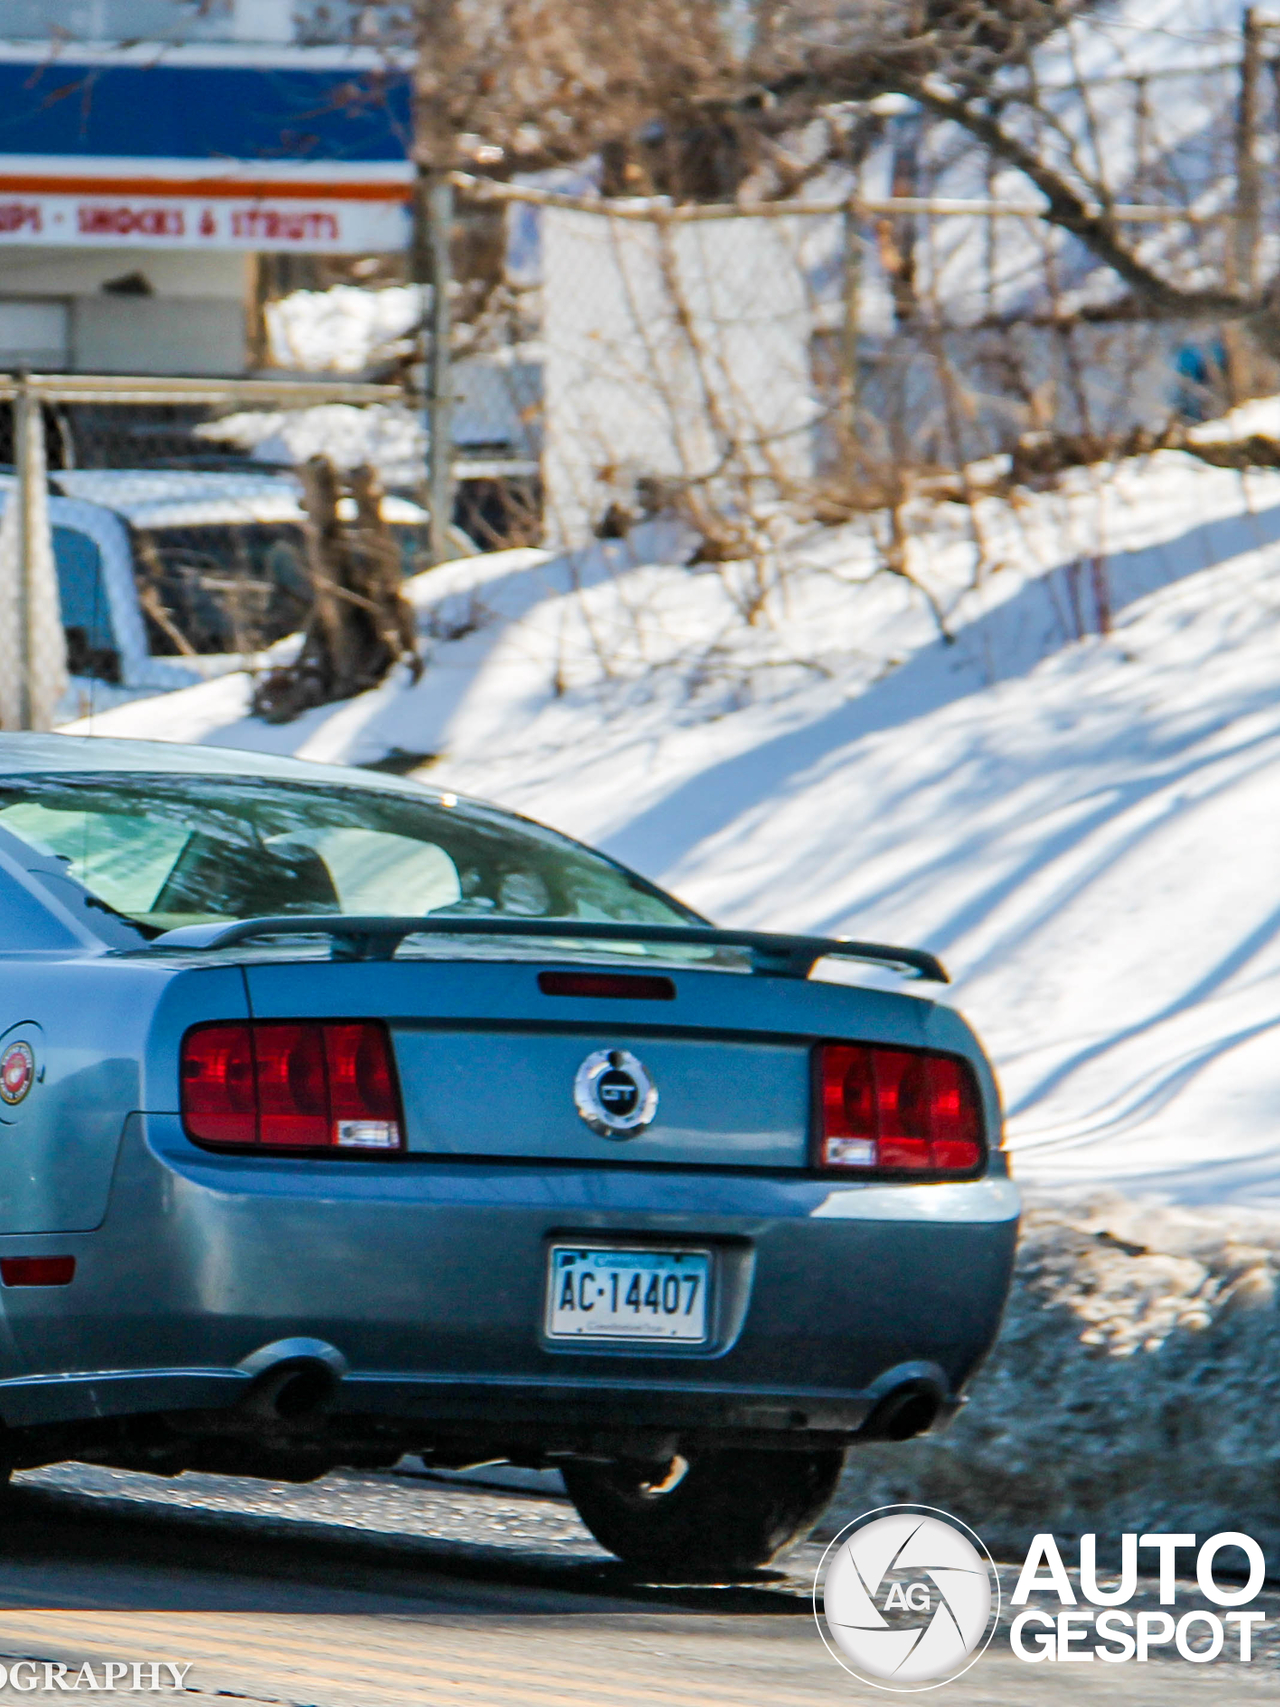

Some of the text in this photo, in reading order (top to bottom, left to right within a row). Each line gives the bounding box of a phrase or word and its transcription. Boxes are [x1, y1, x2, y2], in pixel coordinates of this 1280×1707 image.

[78, 205, 184, 236] SHOCKS
[231, 211, 338, 240] STRUTS
[601, 1085, 636, 1101] GT
